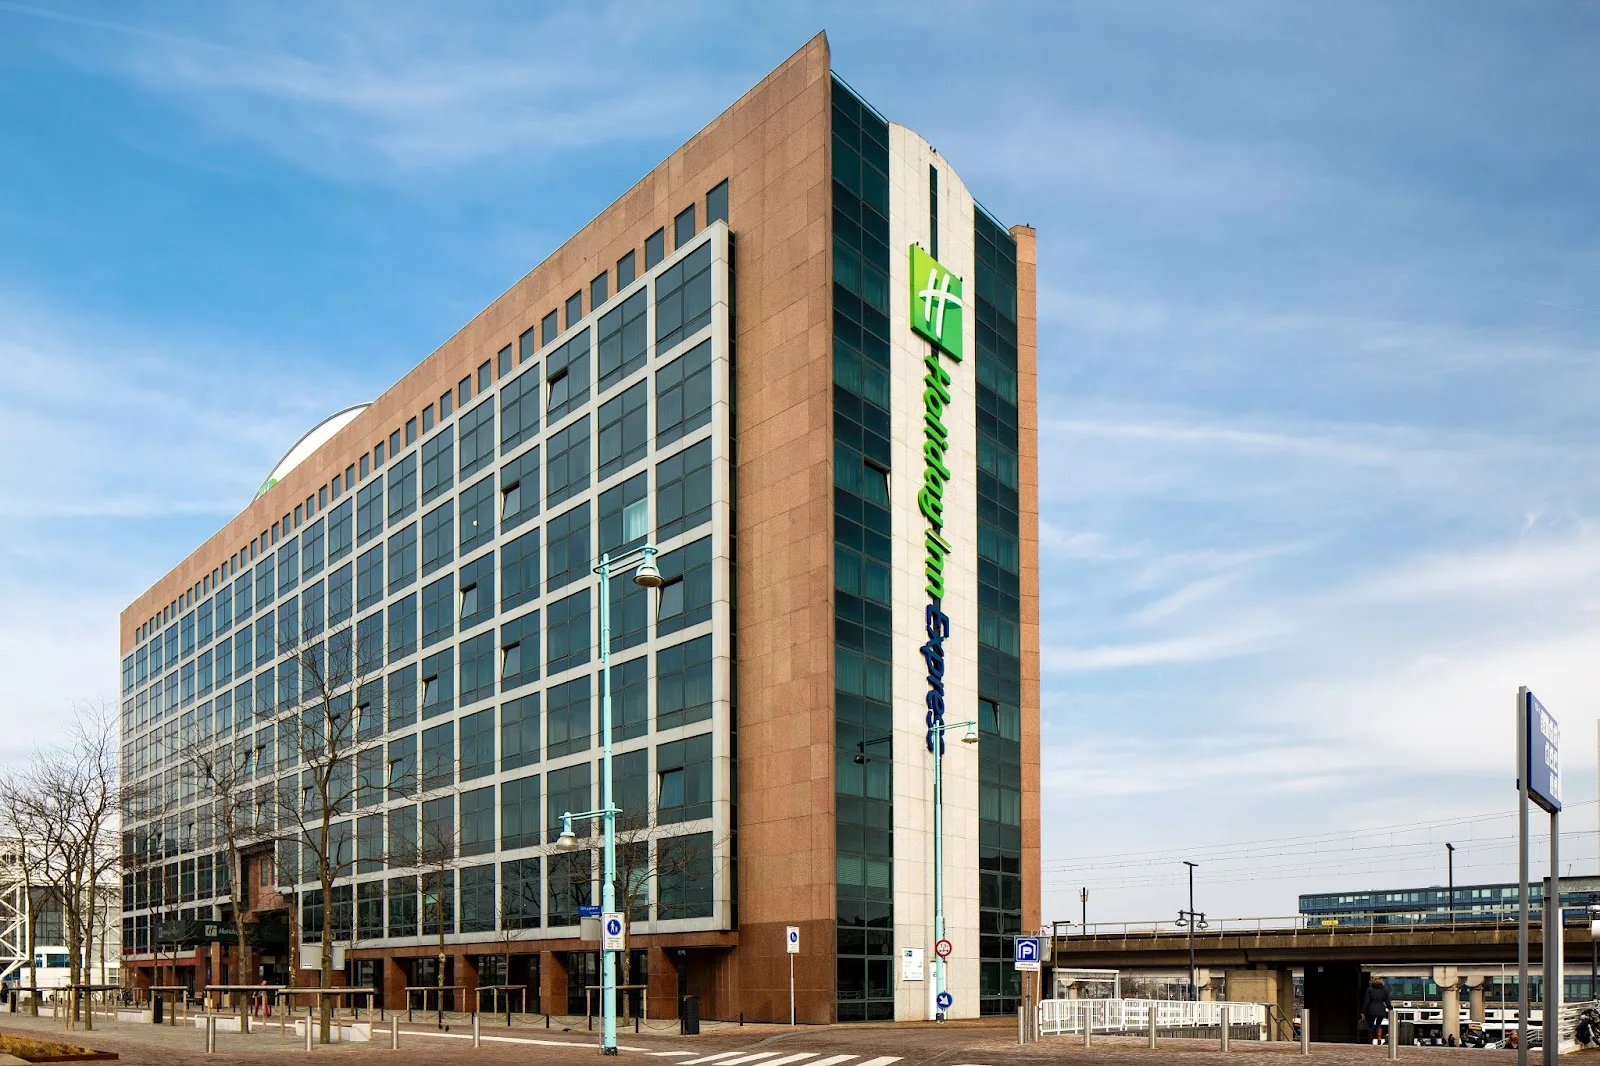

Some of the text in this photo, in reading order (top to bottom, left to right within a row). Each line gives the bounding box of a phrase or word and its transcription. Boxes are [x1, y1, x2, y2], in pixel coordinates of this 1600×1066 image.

[918, 354, 952, 755] Holiday Inn Express
[1022, 946, 1032, 959] P
